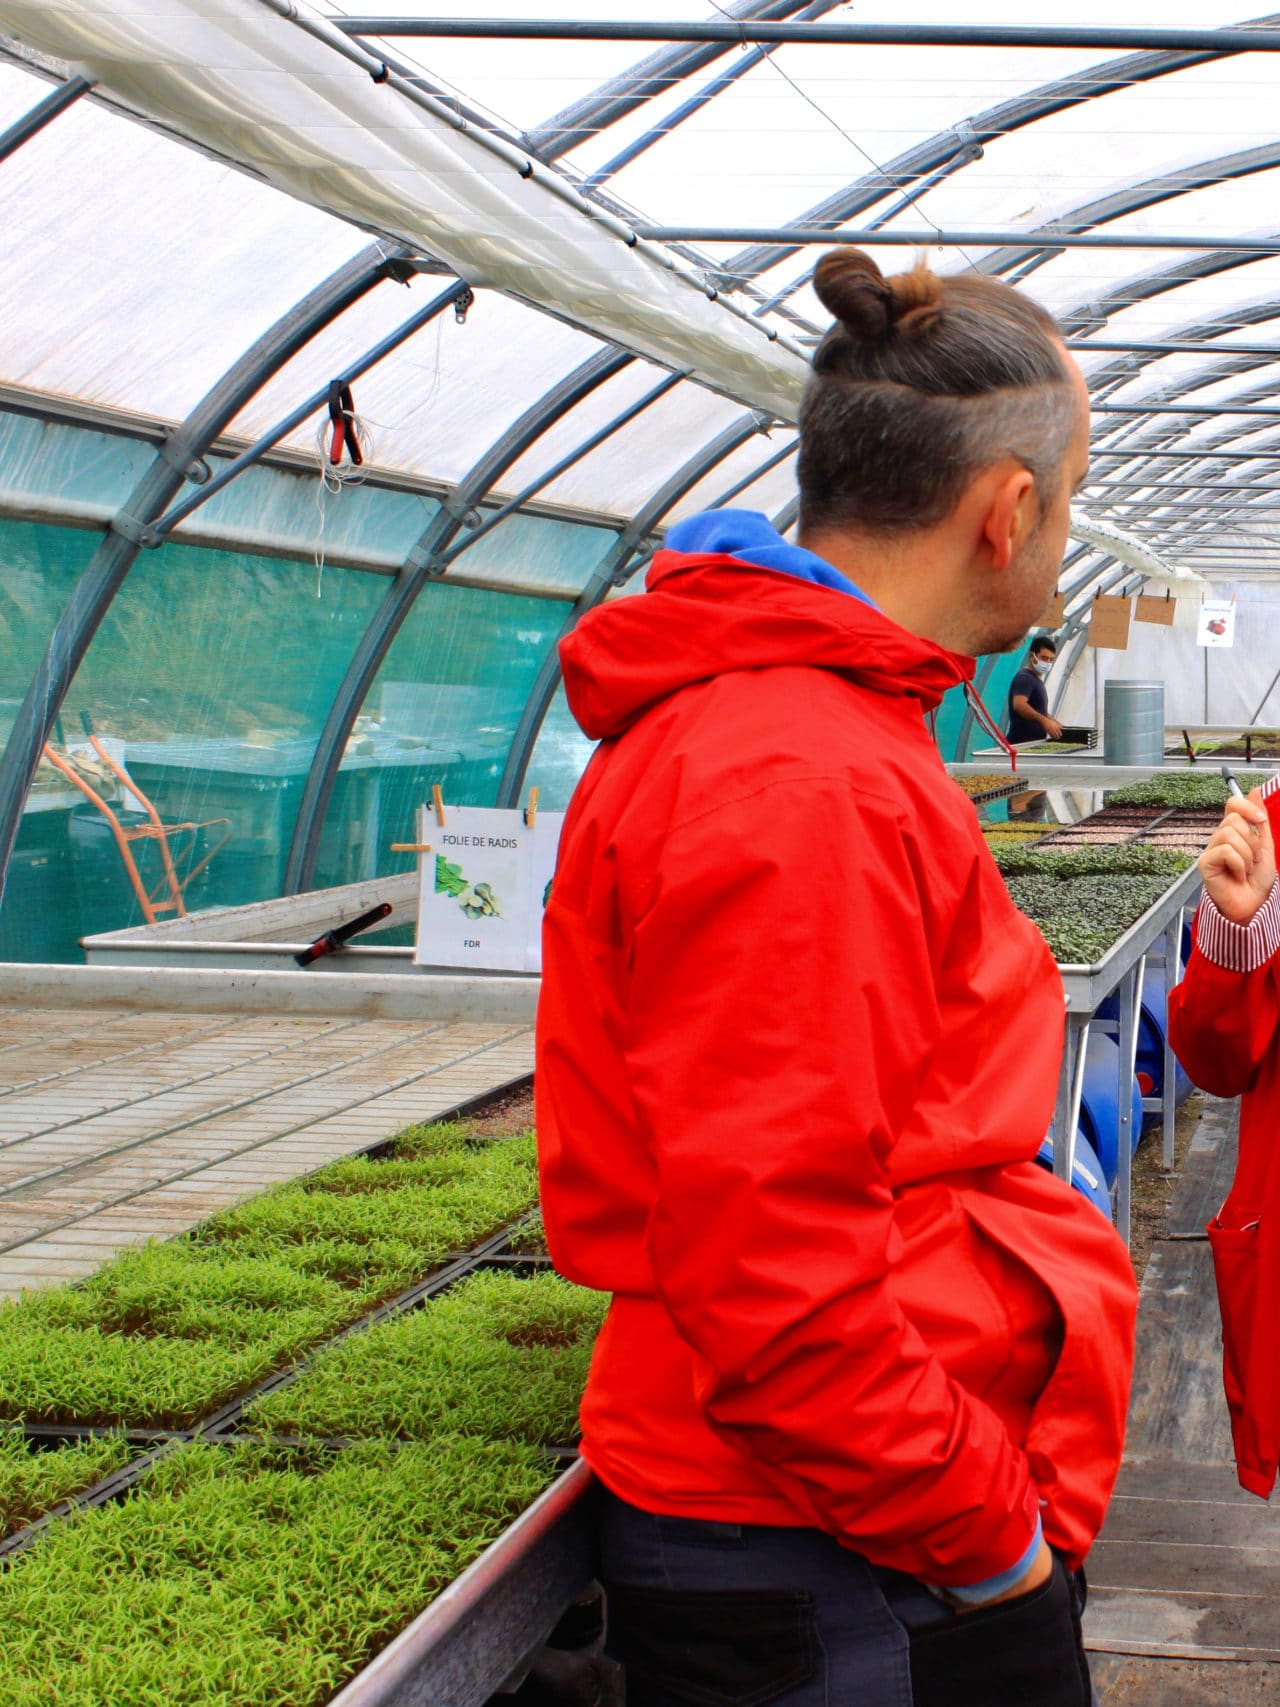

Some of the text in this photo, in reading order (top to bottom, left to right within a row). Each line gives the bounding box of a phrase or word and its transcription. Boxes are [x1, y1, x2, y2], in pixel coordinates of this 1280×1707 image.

[443, 835, 518, 849] FOLIE DE RADIS
[464, 940, 480, 948] FDR
